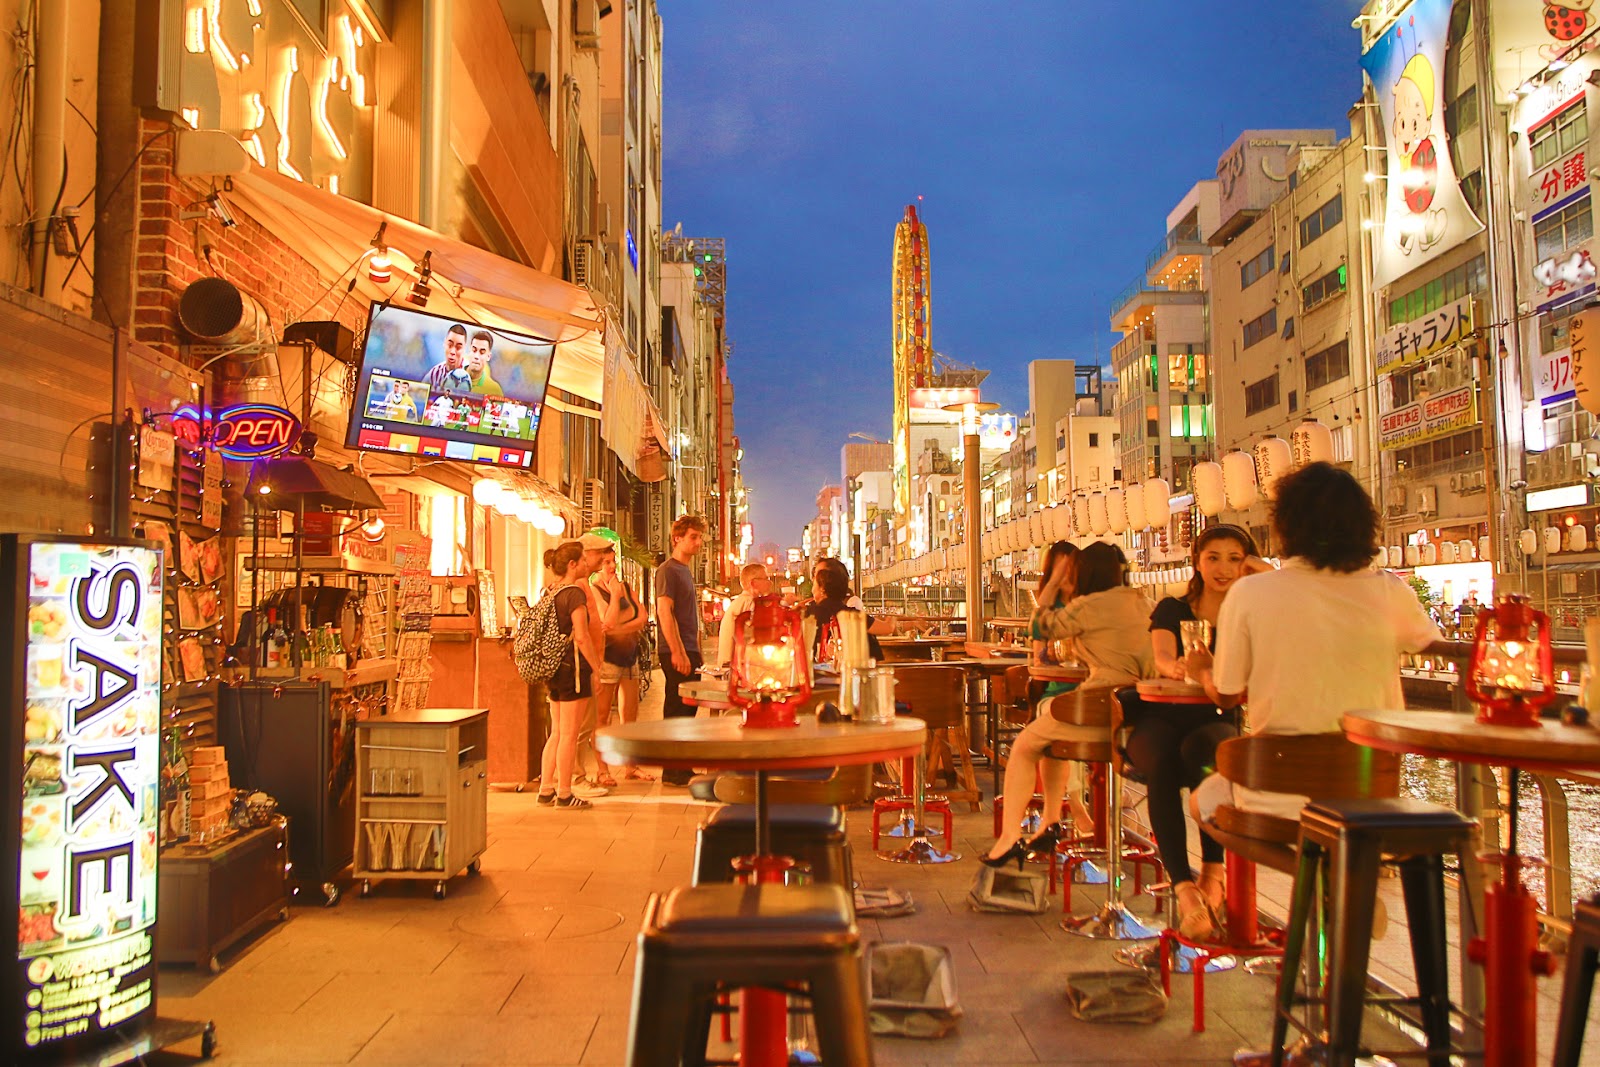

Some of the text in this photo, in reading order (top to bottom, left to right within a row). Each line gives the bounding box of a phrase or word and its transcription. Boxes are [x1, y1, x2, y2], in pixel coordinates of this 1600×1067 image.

[1540, 152, 1586, 203] 分譲
[213, 419, 294, 446] OPEN
[67, 560, 142, 920] SAKE
